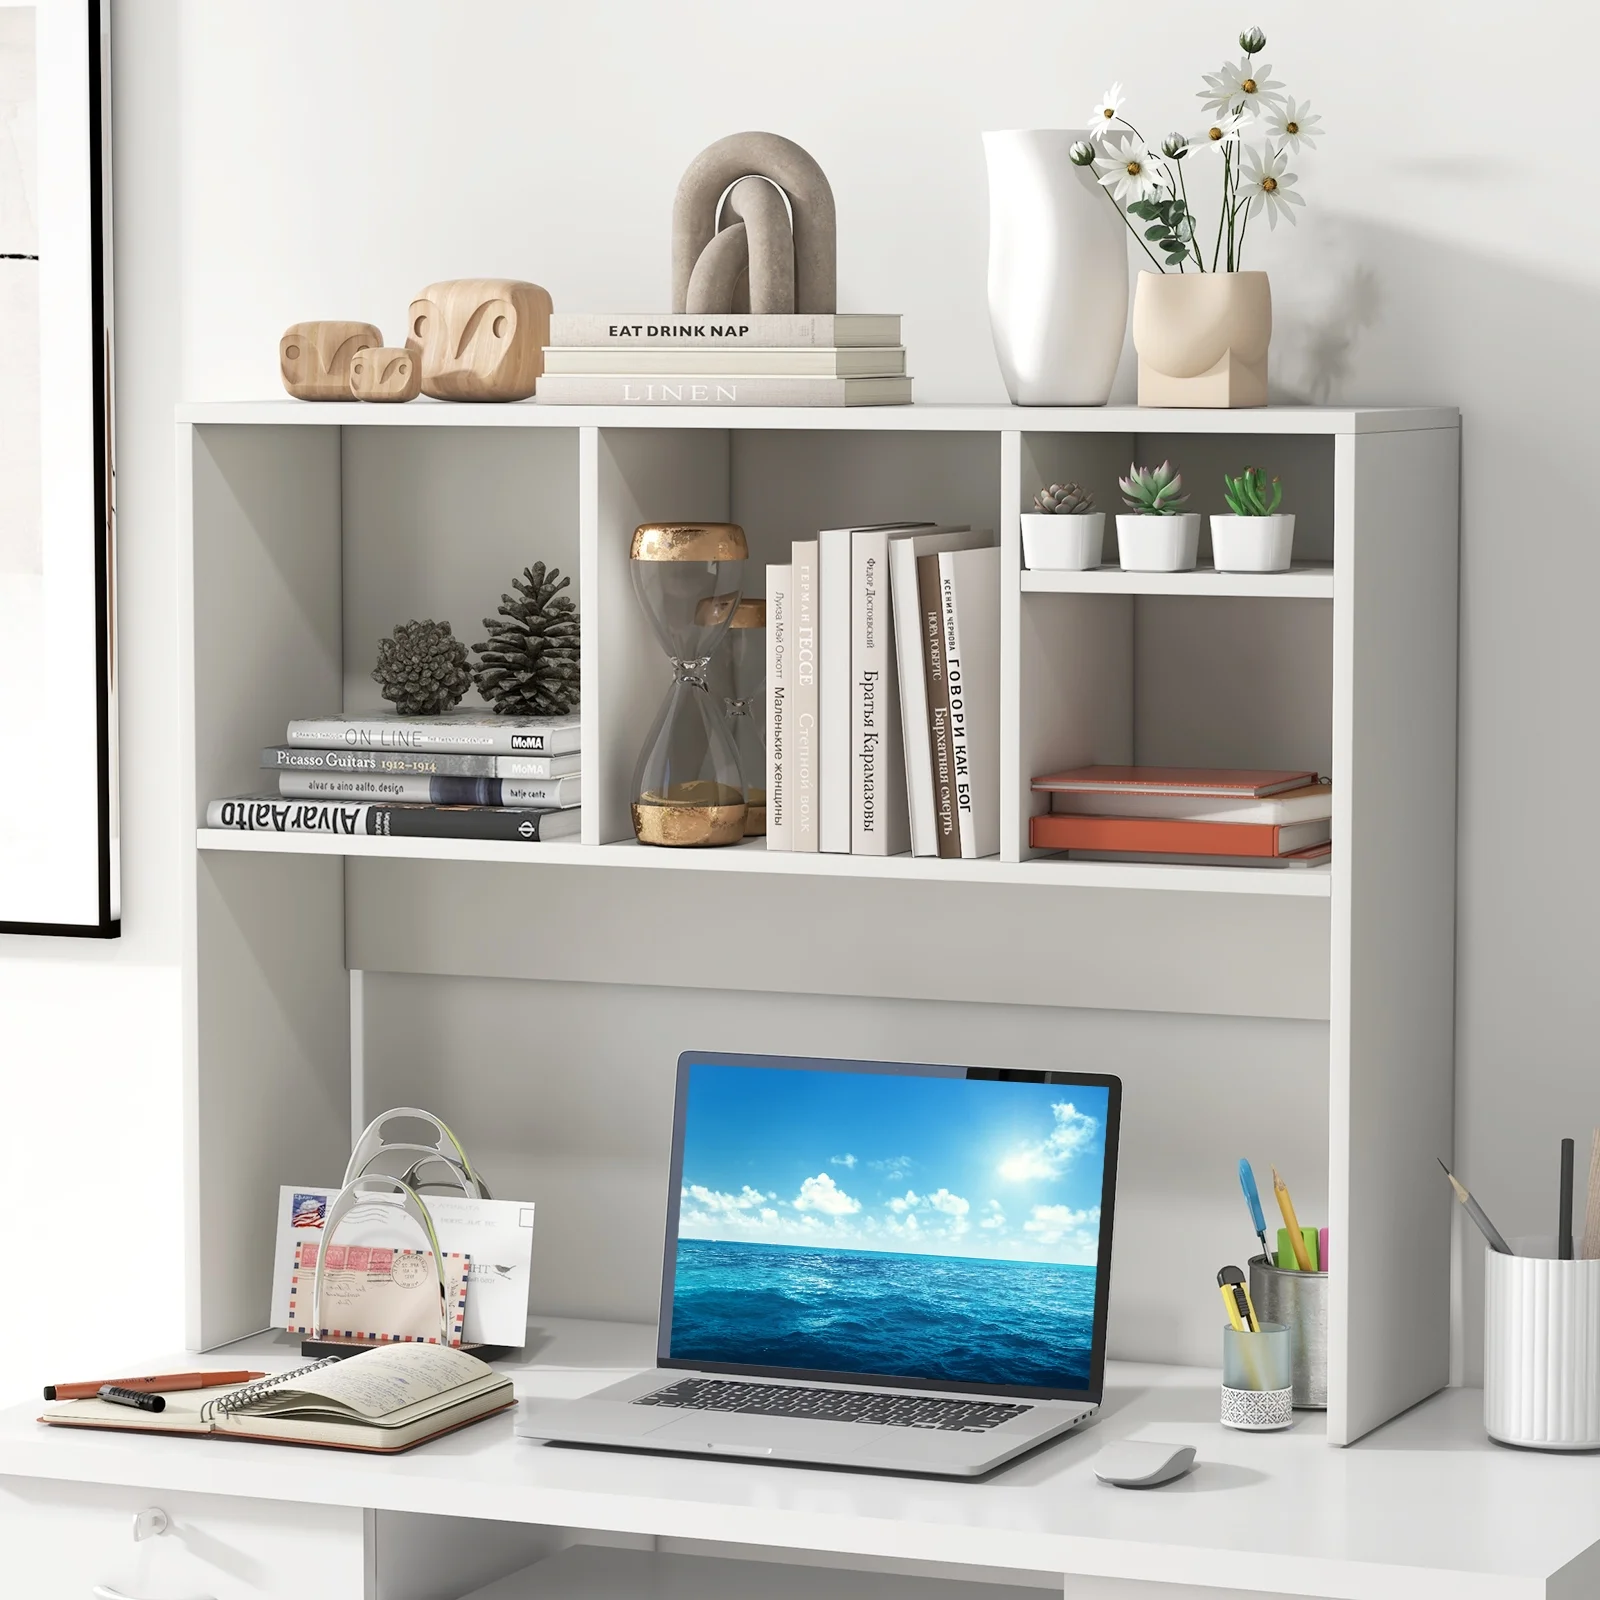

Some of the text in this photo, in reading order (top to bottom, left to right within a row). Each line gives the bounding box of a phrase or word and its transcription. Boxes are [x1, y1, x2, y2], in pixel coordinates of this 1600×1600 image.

[609, 325, 749, 337] EAT DRINK NAP
[622, 384, 738, 401] LINEN
[774, 591, 785, 678] Луиза Мэй Олкотт
[799, 565, 814, 686] ГЕРМАН ГЕССЕ
[943, 579, 956, 651] КСЕНИЯ ЧЕРНОВА
[928, 611, 942, 681] НОРА РОБЕРТС
[345, 728, 422, 748] ON LINE
[512, 736, 543, 749] MoMA
[773, 687, 785, 826] Маленькие женщины
[859, 670, 879, 832] Братья Карамазовы
[948, 659, 971, 813] ГОВОРИ КАК БОГ
[277, 751, 324, 766] Picasso
[325, 752, 376, 769] Guitars
[512, 764, 544, 775] MoMA
[932, 707, 953, 835] Бархатная смерть
[308, 780, 328, 791] alvar
[336, 781, 353, 791] aino
[510, 789, 546, 799] hatje cantz
